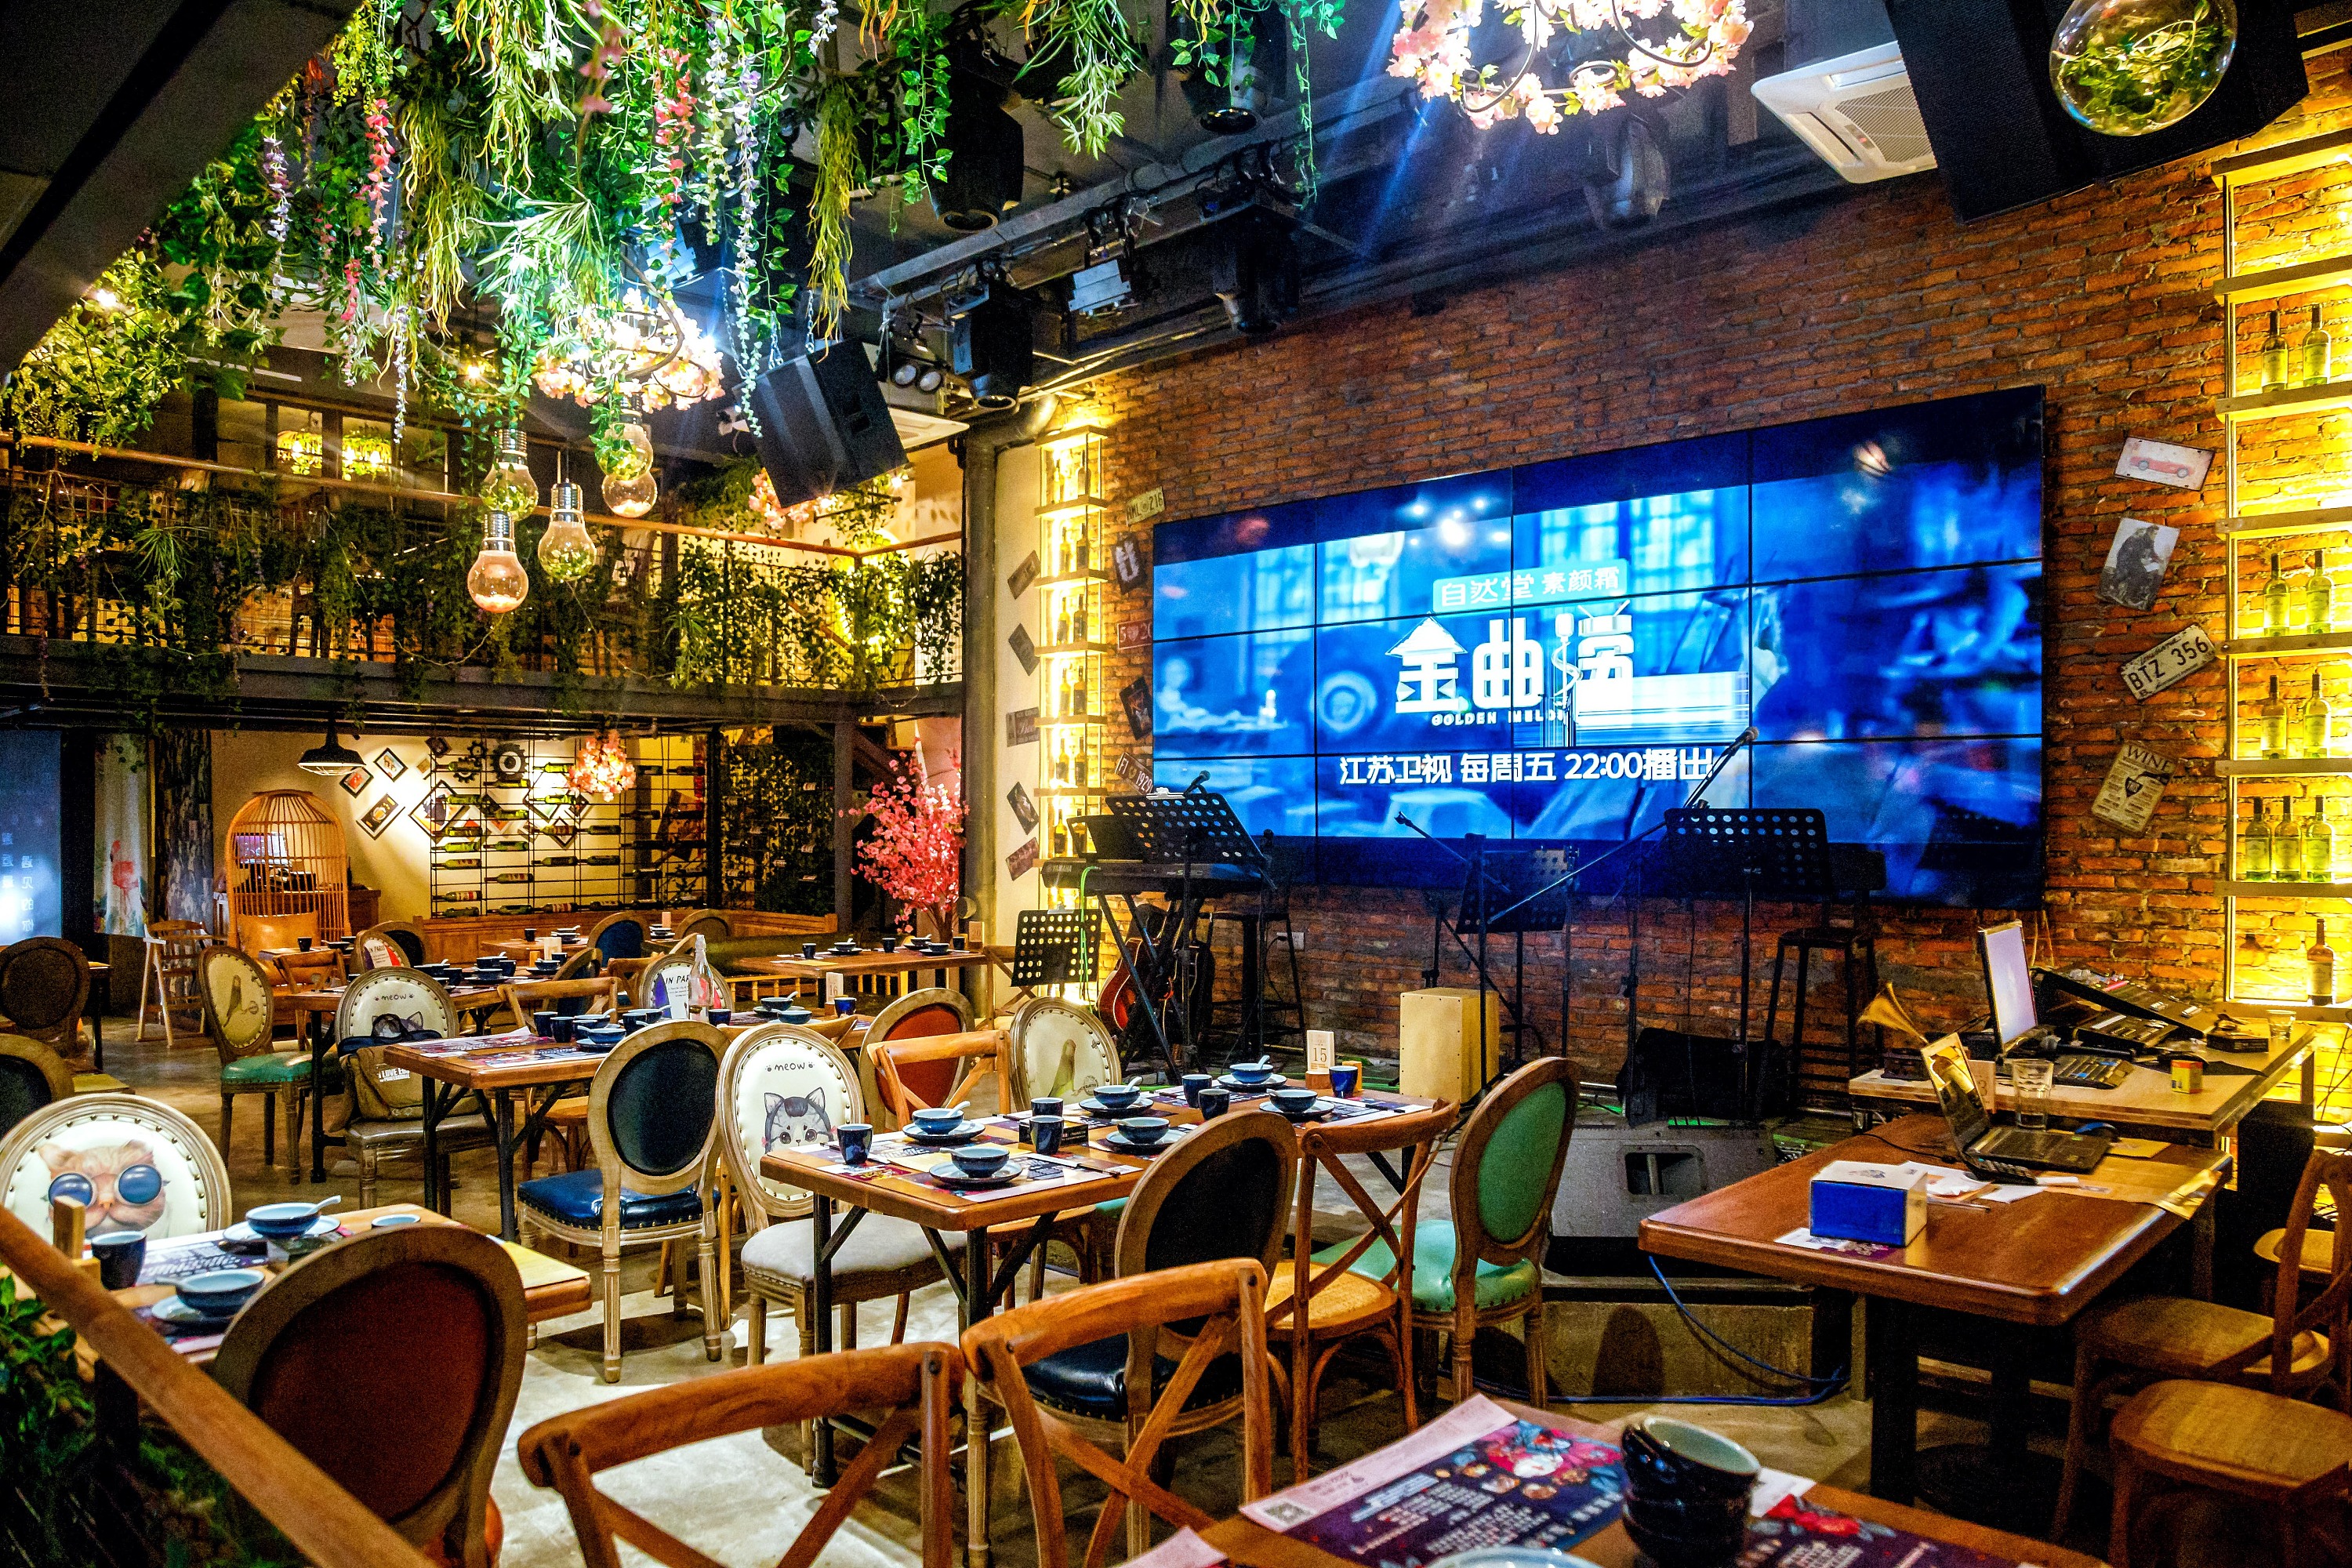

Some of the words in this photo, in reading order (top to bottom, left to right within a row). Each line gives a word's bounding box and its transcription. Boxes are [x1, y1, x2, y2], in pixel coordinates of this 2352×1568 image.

[1149, 492, 1163, 510] 216
[1441, 573, 1534, 607] 自然堂
[1541, 566, 1620, 595] 素颜霜
[2127, 659, 2165, 691] BTZ
[2171, 636, 2209, 666] 356
[1431, 711, 1497, 726] GOLDEN
[1339, 754, 1452, 785] 江苏卫视
[1459, 752, 1557, 782] 每周五
[1565, 748, 1715, 781] 22:00播出
[2127, 745, 2172, 772] WINE
[1313, 1047, 1327, 1062] 15
[774, 1062, 805, 1072] meow
